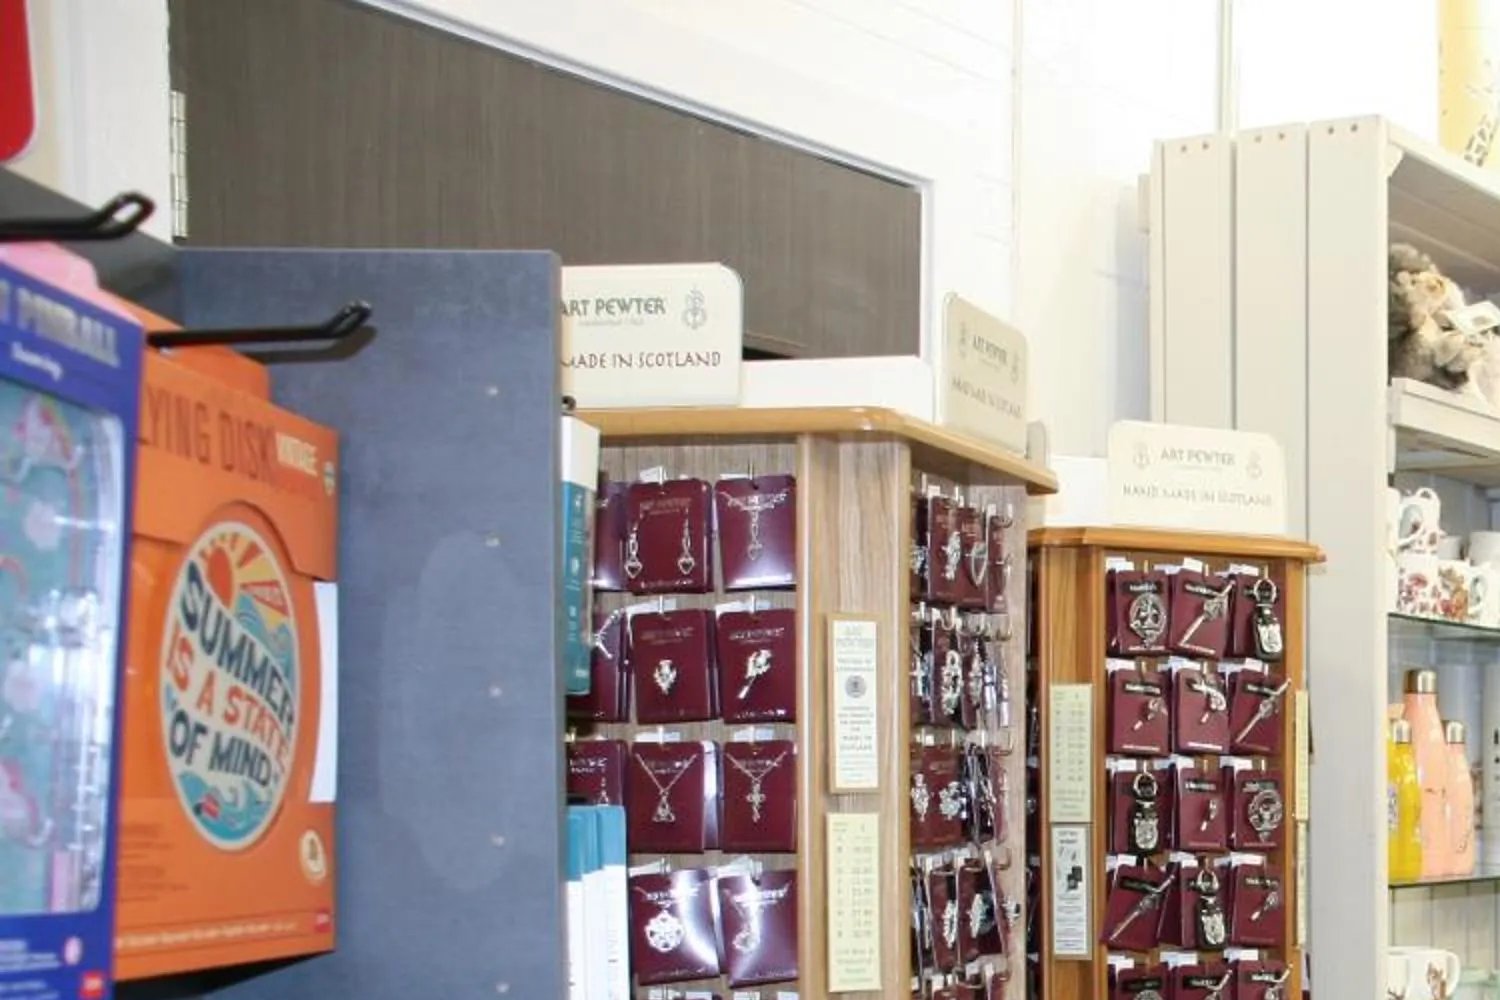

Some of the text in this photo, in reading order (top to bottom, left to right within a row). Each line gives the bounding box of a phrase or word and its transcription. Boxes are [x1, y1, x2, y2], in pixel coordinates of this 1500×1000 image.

[595, 297, 667, 316] PEWTER
[612, 352, 634, 369] IN
[637, 350, 722, 369] SCOTLAND
[179, 559, 296, 731] SUMMER
[166, 620, 291, 777] IS A STATE
[168, 708, 272, 790] OF MIND
